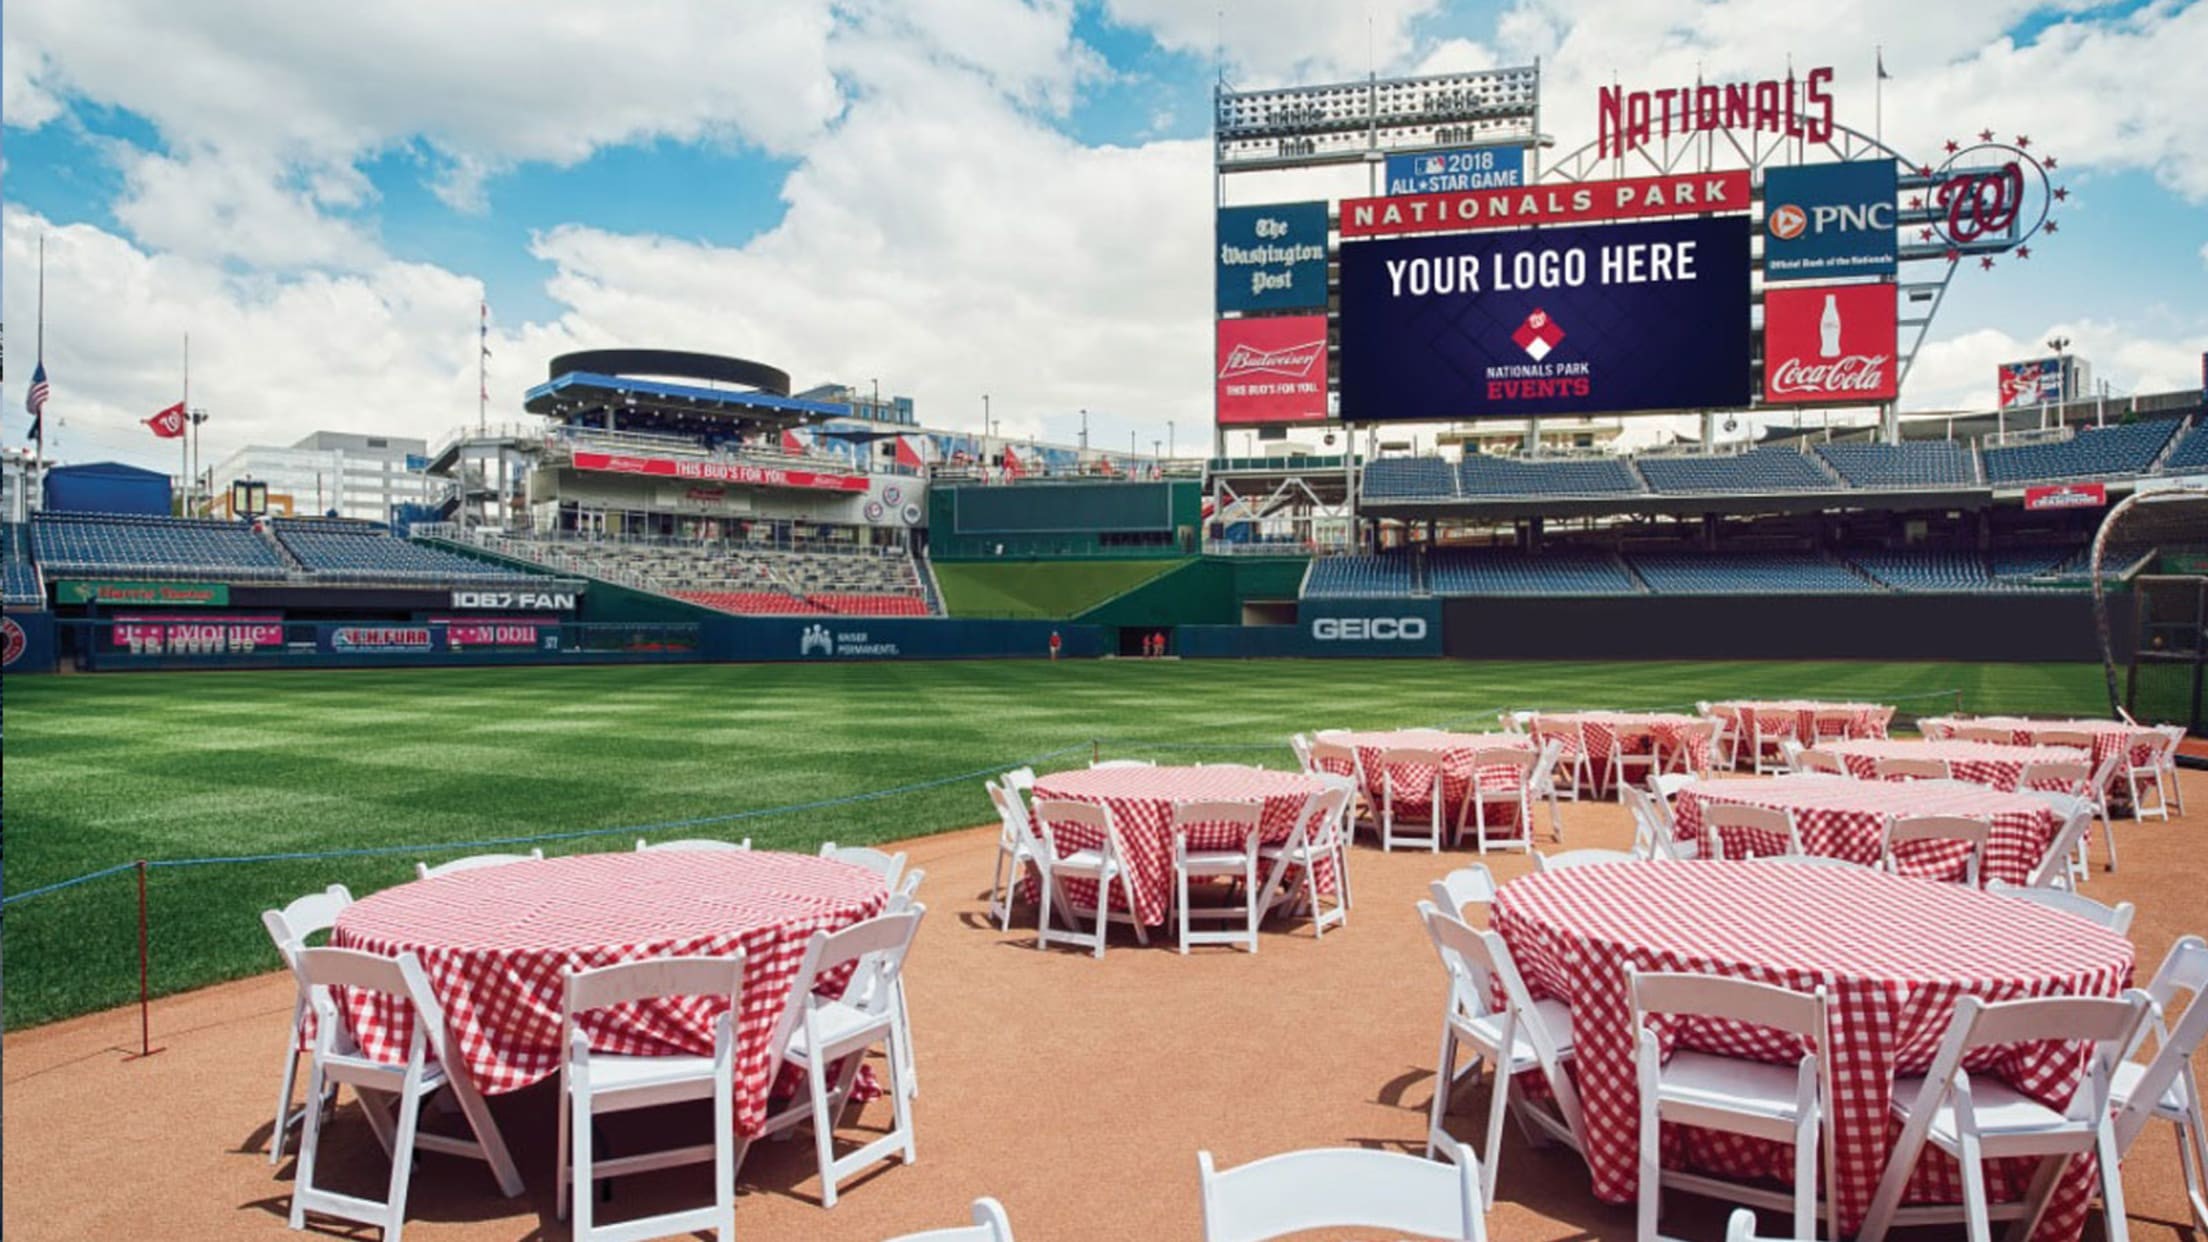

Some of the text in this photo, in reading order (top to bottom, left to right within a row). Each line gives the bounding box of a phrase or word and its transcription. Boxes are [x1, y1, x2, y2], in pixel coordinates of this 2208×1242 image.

[1599, 67, 1833, 160] NATIONALS
[1448, 152, 1494, 173] 2018
[1471, 169, 1518, 189] GAME
[1354, 180, 1728, 228] NATIONALS PARK
[1255, 219, 1288, 239] The
[1811, 202, 1894, 234] PNC
[1221, 243, 1324, 266] Washington
[1386, 241, 1698, 298] YOUR LOGO HERE
[1252, 270, 1293, 295] Post
[1230, 352, 1315, 369] Budweiser
[1486, 362, 1590, 379] NATIONALS PARK
[1772, 355, 1888, 393] Coca-Cola
[1488, 377, 1591, 400] EVENTS
[675, 460, 701, 478] THIS
[740, 466, 761, 482] FOR
[520, 593, 575, 609] FAN
[1312, 617, 1428, 640] GEICO
